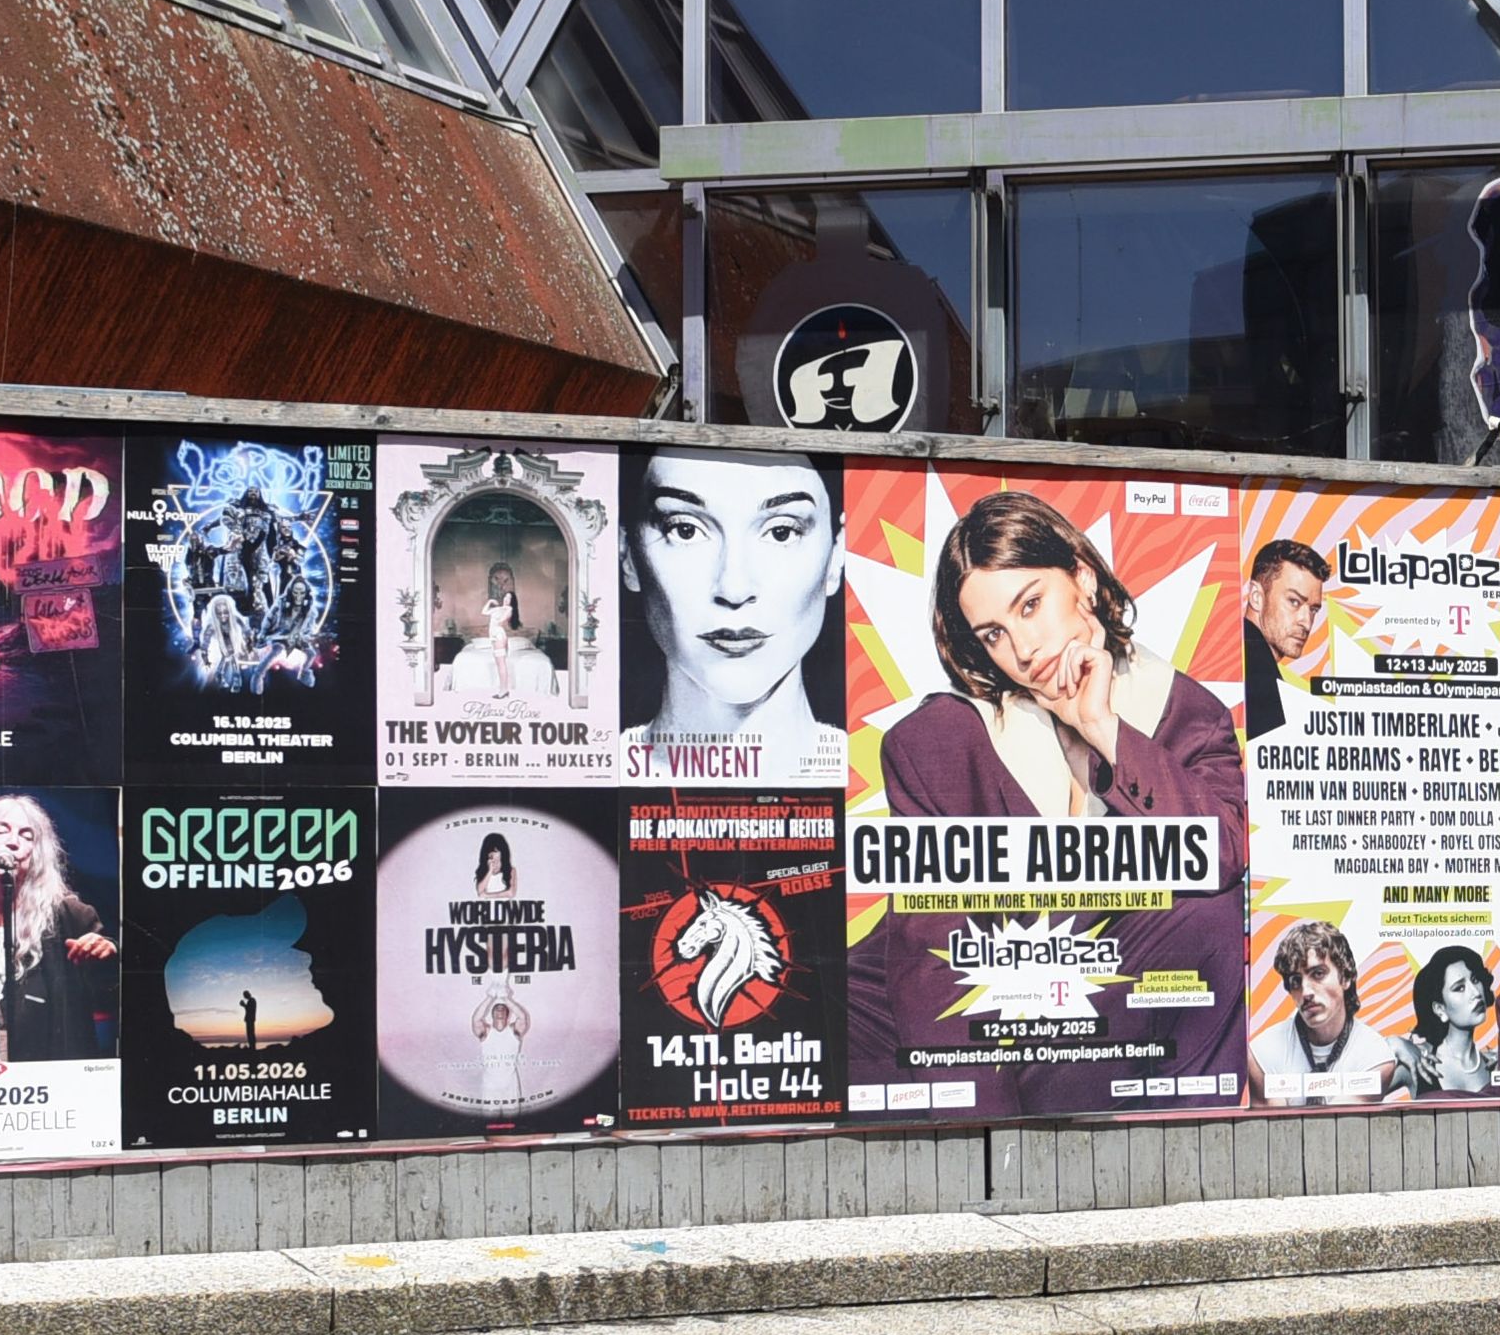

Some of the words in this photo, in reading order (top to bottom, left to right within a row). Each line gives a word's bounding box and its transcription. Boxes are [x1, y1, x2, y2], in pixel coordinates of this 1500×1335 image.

[328, 445, 370, 461] LIMITED
[328, 463, 353, 479] TOUR
[213, 716, 291, 729] 16.10.2025
[1304, 711, 1365, 737] JUSTIN
[1373, 712, 1480, 738] TIMBERLAKE
[170, 733, 254, 746] COLUMBIA
[258, 733, 333, 747] THEATER
[386, 721, 428, 743] THE
[436, 721, 521, 744] VOYEUR
[528, 722, 588, 745] TOUR
[221, 751, 283, 763] BERLIN
[385, 752, 405, 766] 01
[413, 752, 448, 766] SEPT
[465, 753, 519, 767] BERLIN
[547, 753, 612, 767] HUXLEYS
[627, 745, 660, 778] ST.
[668, 746, 762, 778] VINCENT
[1257, 745, 1320, 771] GRACIE
[1326, 746, 1401, 771] ABRAMS
[1419, 748, 1461, 772] RAYE
[1266, 780, 1315, 801] ARMIN
[1320, 780, 1348, 801] VAN
[1352, 780, 1407, 801] BUUREN
[1281, 810, 1303, 826] THE
[1306, 810, 1334, 826] LAST
[1337, 810, 1378, 826] DINNER
[1381, 810, 1415, 826] PARTY
[1430, 810, 1455, 826] DOM
[1460, 810, 1494, 826] DOLLA
[630, 819, 653, 838] DIE
[657, 819, 784, 838] APOKALYPTISCHEN
[789, 819, 834, 837] REITER
[853, 824, 1008, 884] GRACIE
[1026, 823, 1208, 883] ABRAMS
[142, 864, 274, 889] OFFLINE
[277, 859, 352, 891] 2026
[903, 894, 958, 910] TOGETHER
[962, 894, 990, 909] WITH
[994, 893, 1025, 909] MORE
[1029, 893, 1058, 908] THAN
[1061, 893, 1076, 908] 50
[1079, 892, 1122, 908] ARTISTS
[1125, 892, 1147, 907] LIVE
[1151, 892, 1163, 907] AT
[1383, 887, 1408, 903] AND
[1413, 886, 1450, 903] MANY
[1454, 886, 1490, 902] MORE
[449, 900, 545, 925] WORLDWIDE
[425, 926, 576, 975] HYSTERIA
[983, 1023, 1027, 1037] 12+13
[1031, 1022, 1058, 1037] July
[1063, 1022, 1096, 1035] 2025
[647, 1034, 728, 1067] 14.11.
[734, 1032, 821, 1064] Berlin
[194, 1062, 306, 1081] 11.05.2026
[168, 1083, 331, 1104] COLUMBIAHALLE
[694, 1069, 770, 1102] Hole
[780, 1067, 822, 1098] 44
[213, 1107, 288, 1124] BERLIN
[628, 1107, 687, 1120] TICKETS:
[689, 1101, 841, 1118] WWW.REITERMANIA.DE
[91, 1139, 107, 1148] taz
